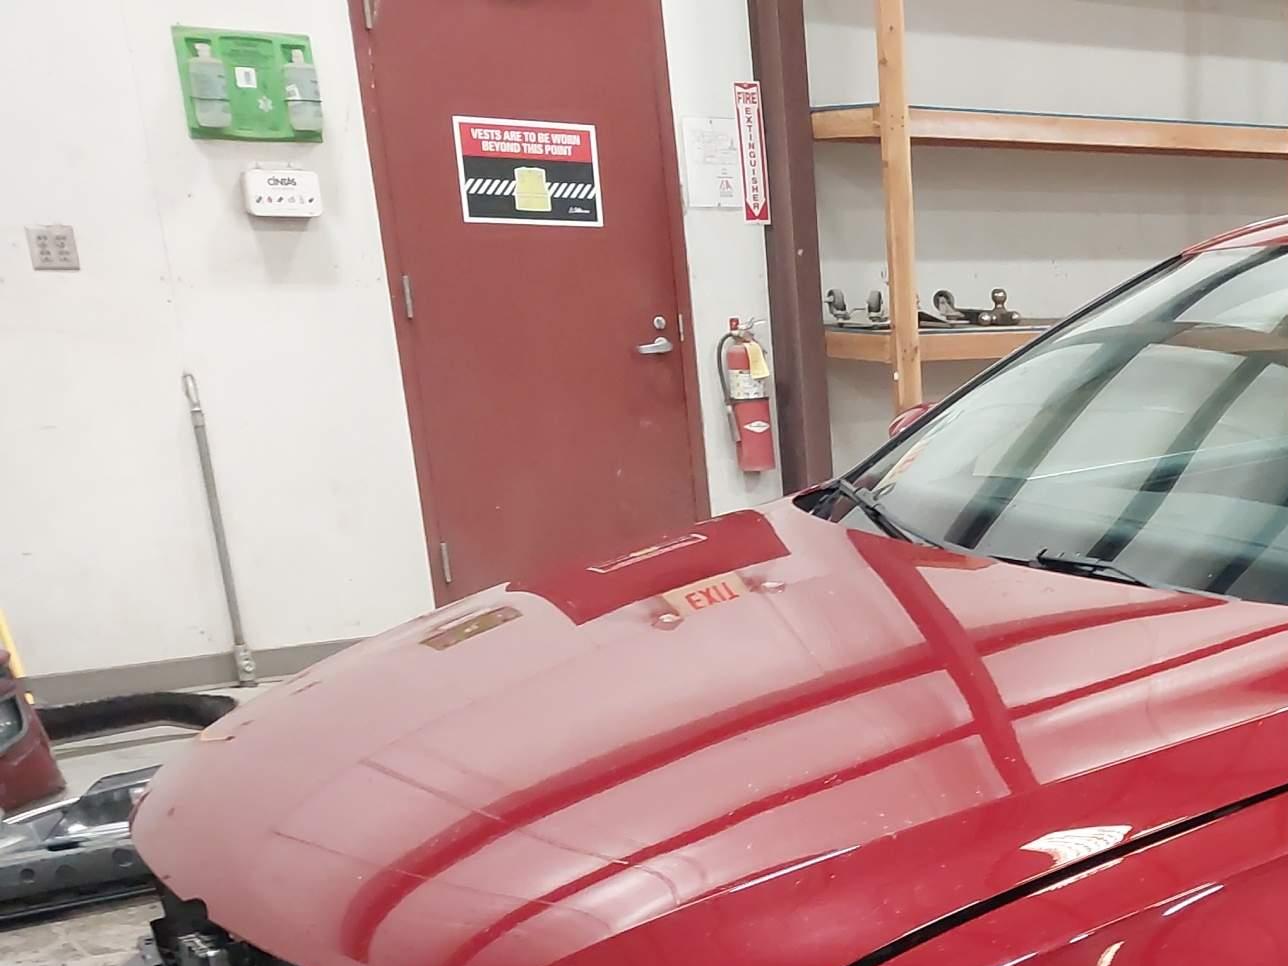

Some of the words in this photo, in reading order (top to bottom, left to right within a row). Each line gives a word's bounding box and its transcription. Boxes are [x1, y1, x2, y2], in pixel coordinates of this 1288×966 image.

[737, 91, 758, 104] FIRE
[470, 128, 502, 141] VESTS
[503, 130, 522, 142] ARE
[523, 131, 536, 143] TO
[537, 132, 551, 144] BE
[551, 133, 580, 146] WORN
[481, 140, 520, 153] BEYOND
[522, 143, 543, 155] THIS
[544, 144, 572, 156] POINT
[744, 107, 760, 210] EXTINGUISHER
